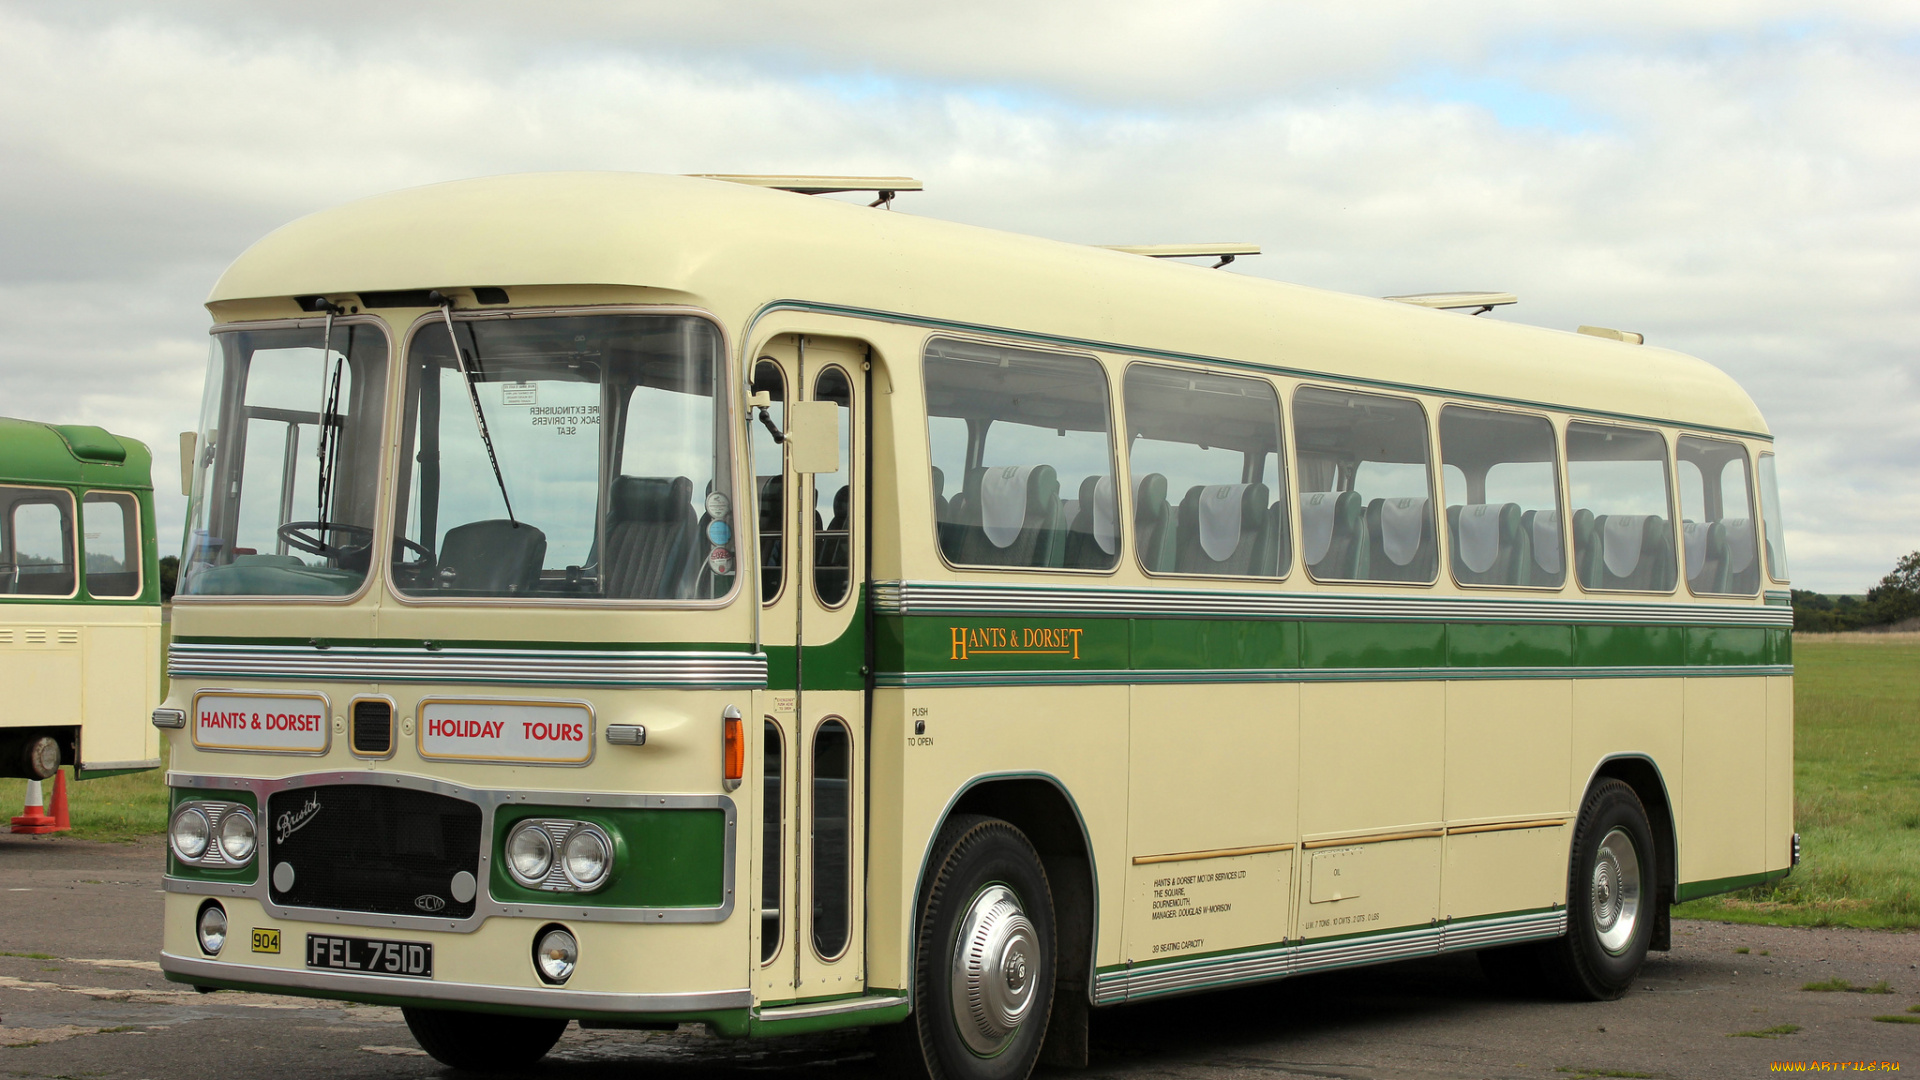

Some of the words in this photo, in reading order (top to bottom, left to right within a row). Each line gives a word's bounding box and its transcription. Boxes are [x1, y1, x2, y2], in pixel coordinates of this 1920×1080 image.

[950, 627, 1006, 660] HANTS
[1010, 630, 1019, 648] &
[1023, 627, 1083, 660] DORSET
[912, 708, 928, 716] PUSH
[201, 711, 247, 730] HANTS
[250, 712, 262, 730] &
[266, 713, 321, 731] DORSET
[428, 719, 505, 739] HOLIDAY
[523, 722, 583, 742] TOURS
[908, 738, 916, 746] TO
[918, 738, 934, 746] OPEN
[276, 790, 321, 845] Bristol
[1154, 878, 1171, 887] HANTS
[1176, 876, 1196, 885] DORSET
[1196, 874, 1214, 883] MOTOR
[1215, 872, 1237, 881] SERVICES
[1238, 870, 1246, 878] LTD
[1154, 890, 1164, 898] THE
[418, 896, 442, 910] ECW
[1178, 906, 1202, 917] DOUGLAS
[253, 932, 279, 950] 904
[1152, 944, 1160, 954] 39
[1160, 942, 1180, 952] SEATING
[1181, 938, 1204, 950] CAPACITY
[313, 937, 361, 969] FEL
[367, 941, 425, 975] 751D
